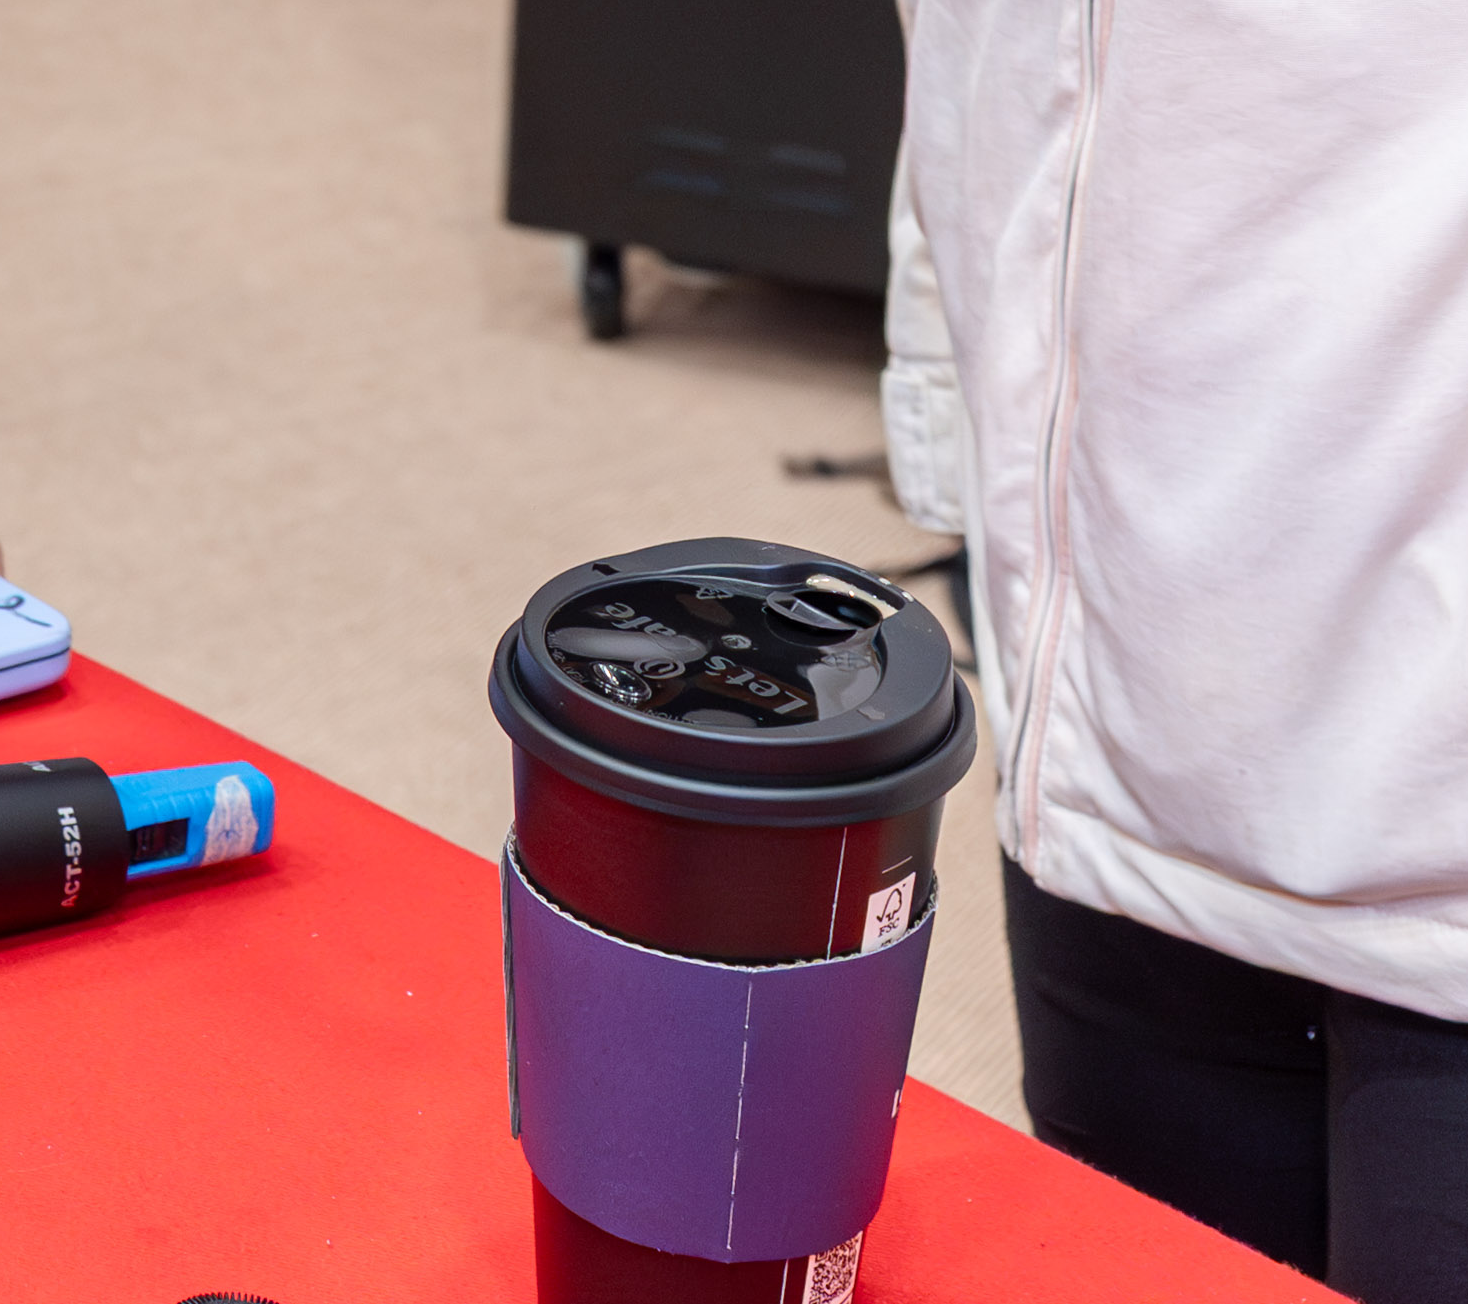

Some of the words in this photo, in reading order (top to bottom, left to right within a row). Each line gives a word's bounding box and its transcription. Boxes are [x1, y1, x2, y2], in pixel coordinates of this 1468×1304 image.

[704, 655, 808, 715] Let's
[57, 806, 82, 908] ACT-52H
[878, 917, 900, 938] FSC
